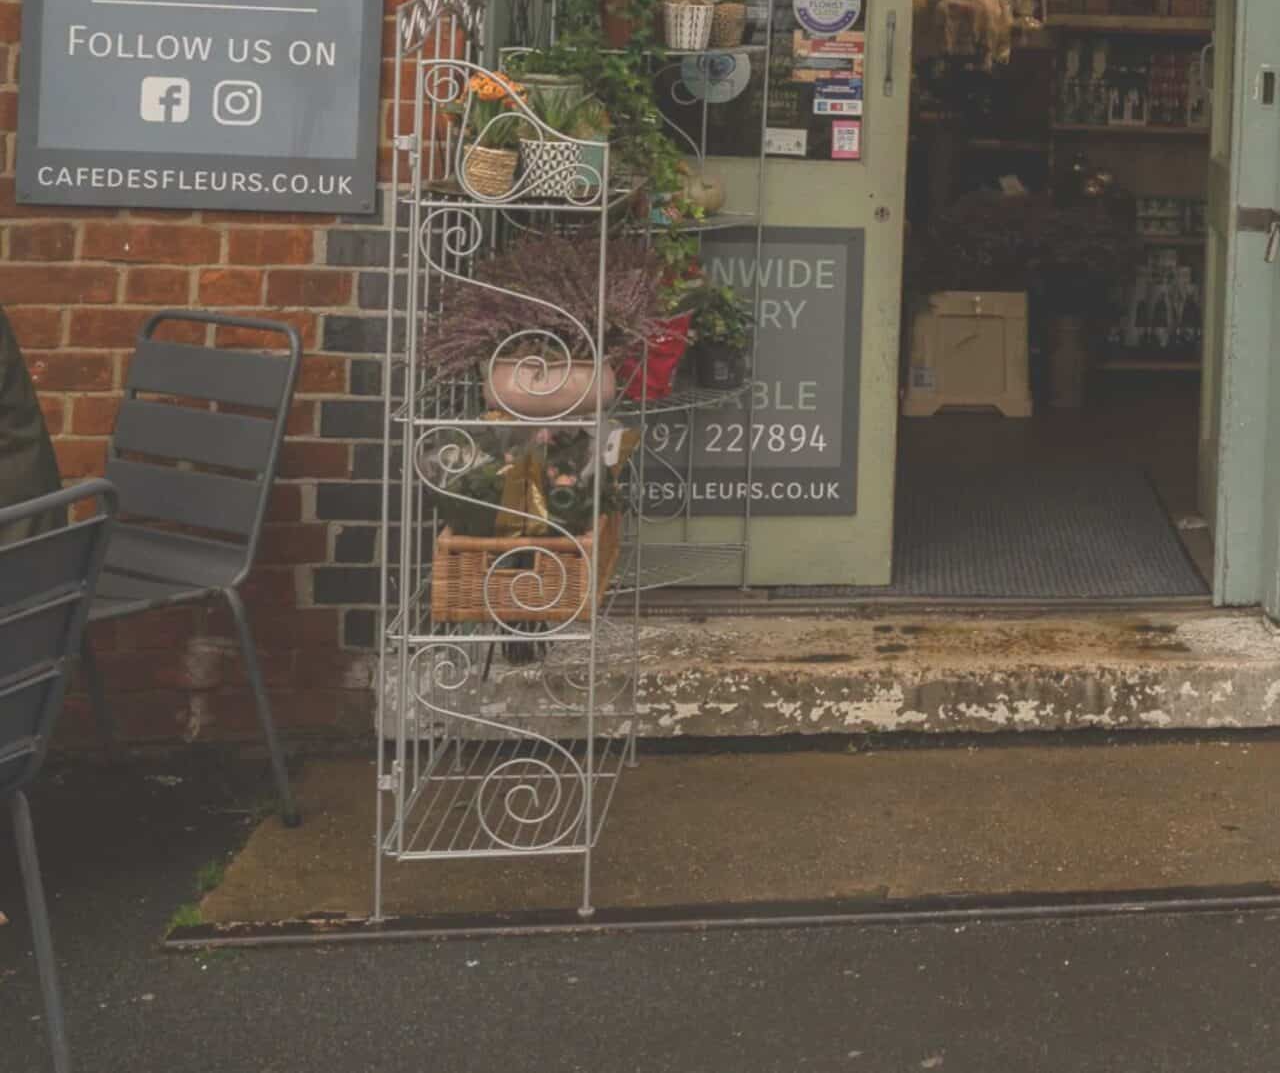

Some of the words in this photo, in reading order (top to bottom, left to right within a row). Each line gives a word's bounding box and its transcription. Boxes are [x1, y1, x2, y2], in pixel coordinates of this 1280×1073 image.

[68, 25, 211, 62] FOLLOW
[228, 39, 272, 65] US
[289, 40, 336, 66] ON
[37, 165, 352, 196] CAFEDESFLEURS.CO.UK
[704, 257, 836, 290] NWIDE
[705, 423, 828, 453] 227894
